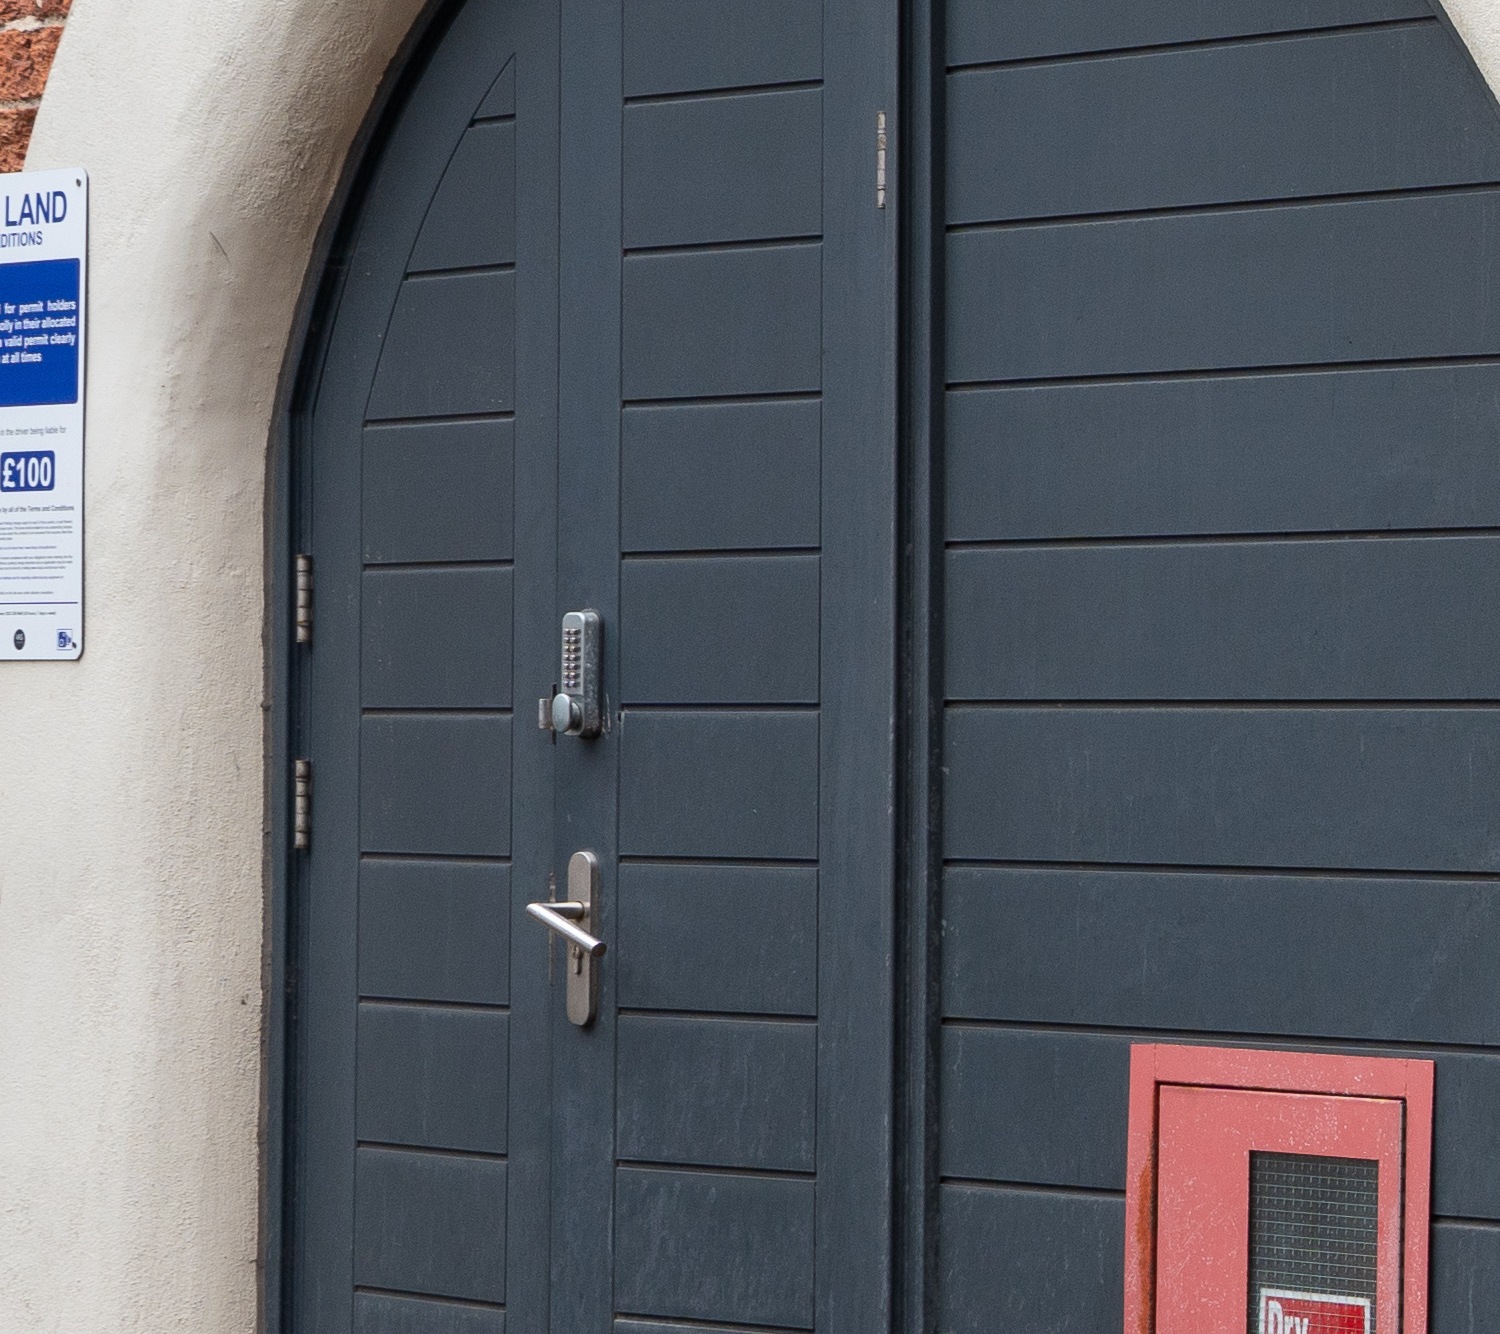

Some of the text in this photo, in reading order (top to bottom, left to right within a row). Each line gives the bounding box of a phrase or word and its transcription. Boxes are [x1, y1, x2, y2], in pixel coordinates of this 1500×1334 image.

[5, 191, 67, 226] LAND
[0, 231, 43, 248] DITIONS
[4, 299, 76, 316] for permit holders
[23, 318, 40, 329] their
[41, 315, 76, 328] allocated
[4, 332, 76, 348] valid permit clearly
[21, 351, 42, 363] times
[3, 457, 52, 488] £100
